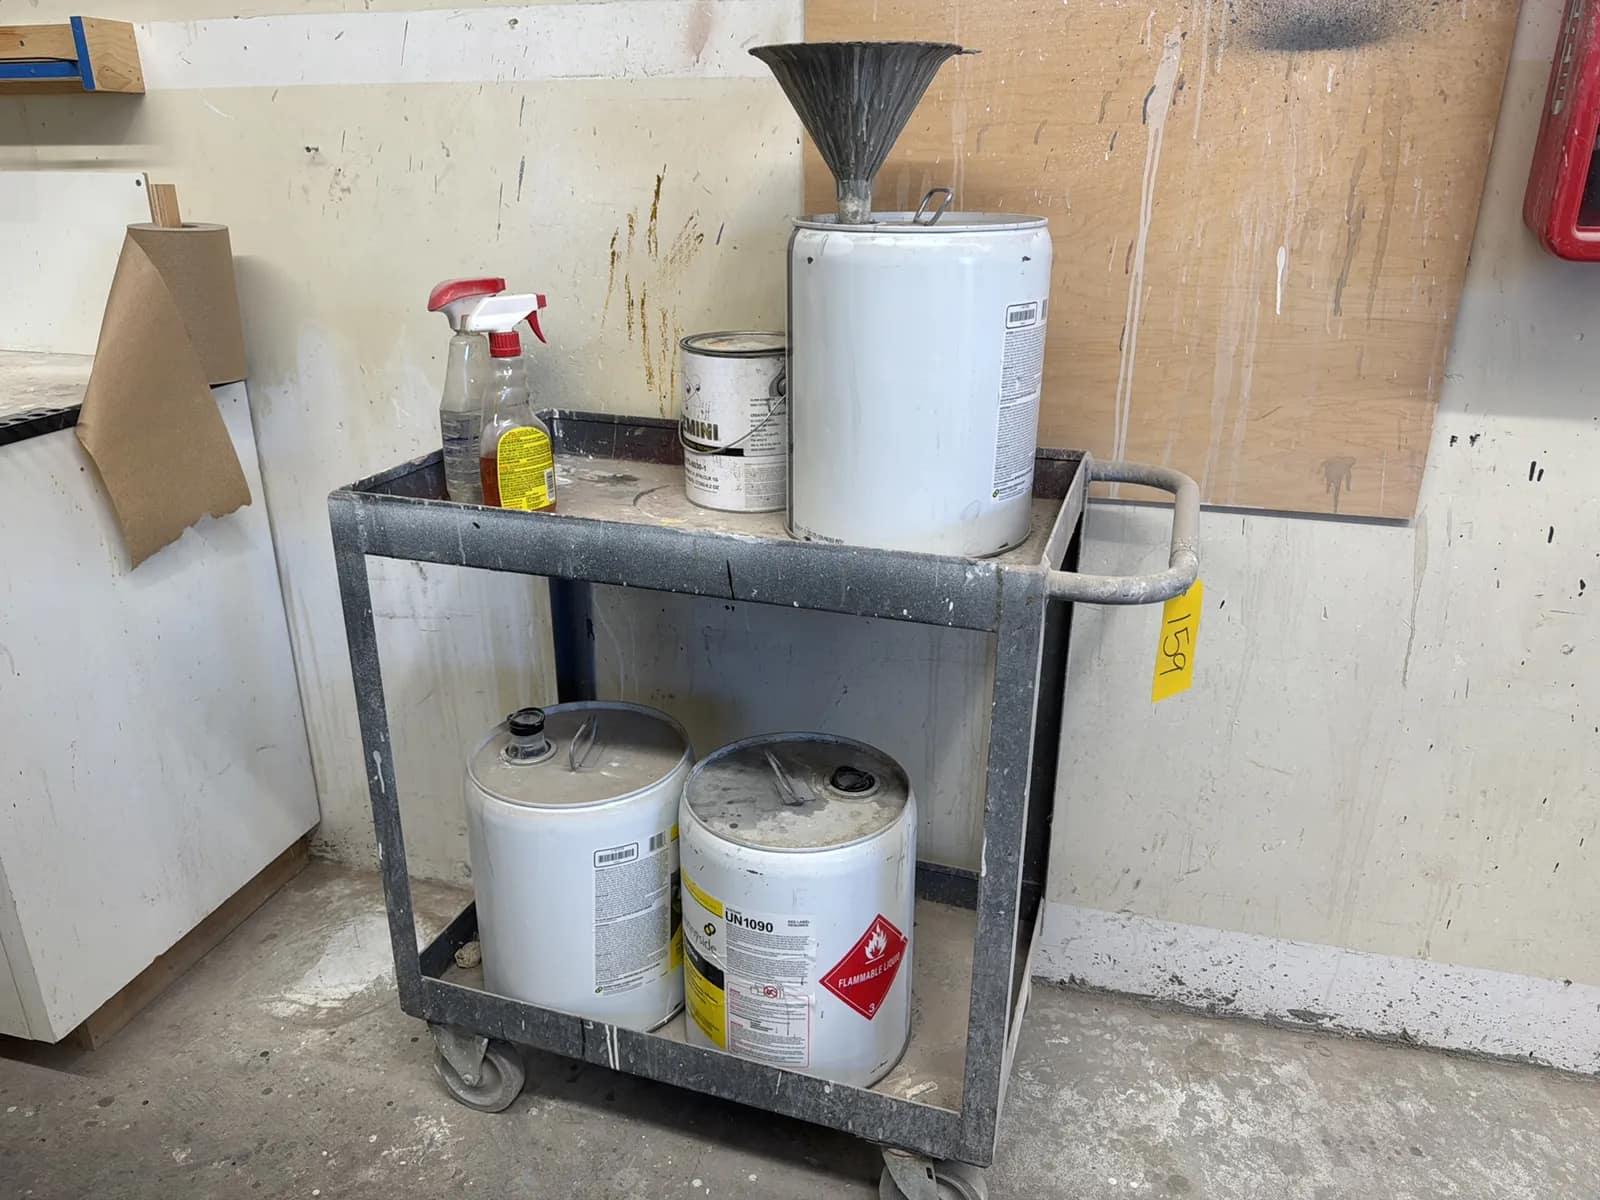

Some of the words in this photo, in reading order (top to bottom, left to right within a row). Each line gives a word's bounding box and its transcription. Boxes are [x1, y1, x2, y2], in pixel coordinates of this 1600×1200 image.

[682, 415, 719, 441] EMINI
[1160, 613, 1192, 676] 159
[725, 910, 774, 933] UN1090
[838, 964, 883, 989] FLAMMABLE
[868, 1002, 876, 1013] 3
